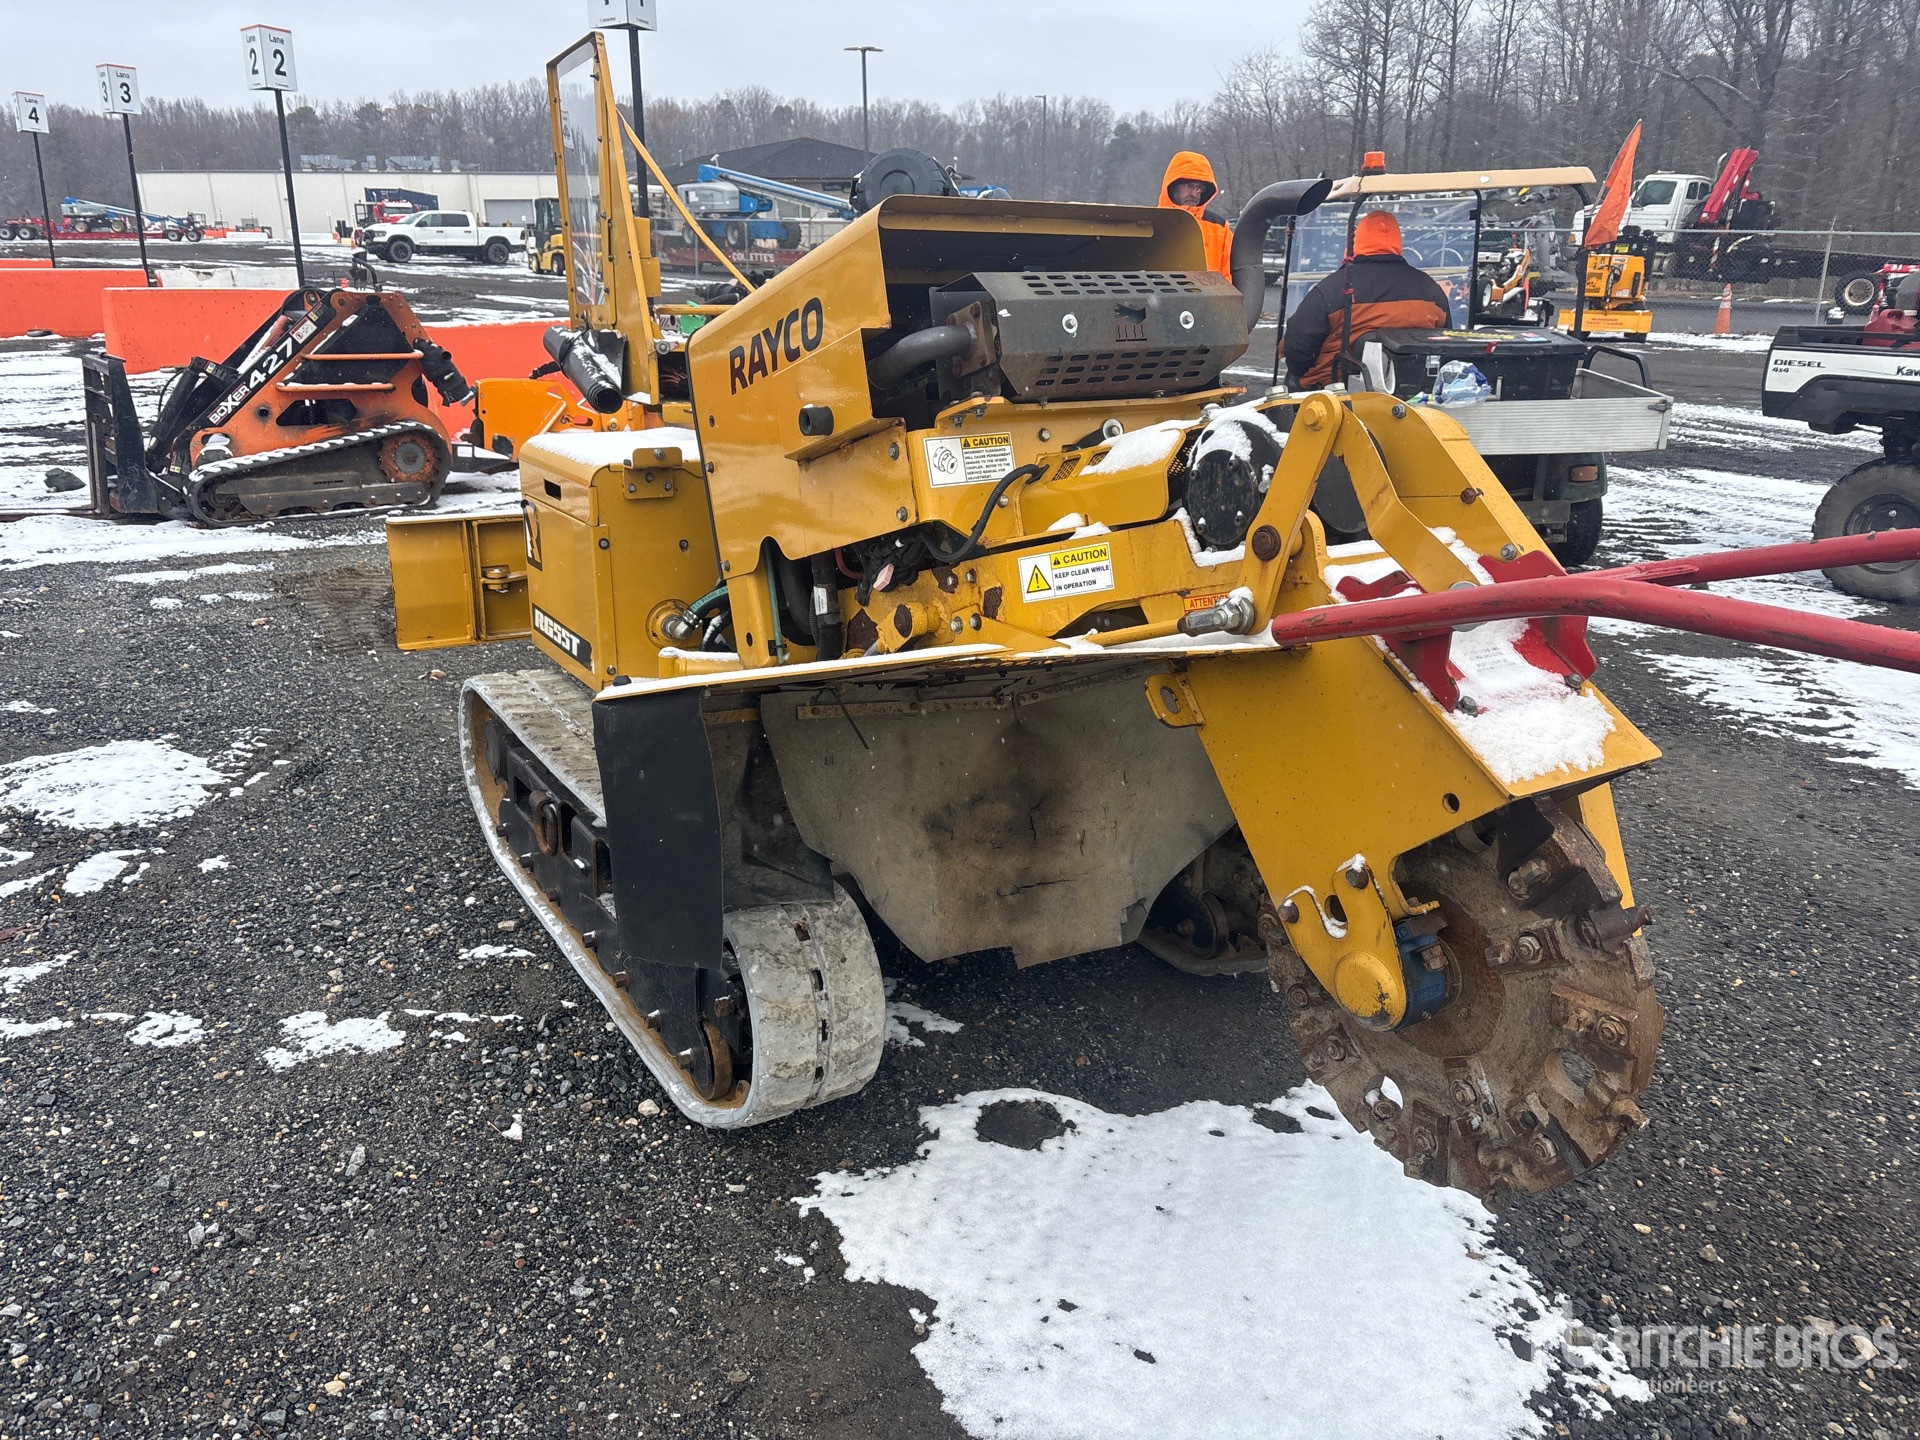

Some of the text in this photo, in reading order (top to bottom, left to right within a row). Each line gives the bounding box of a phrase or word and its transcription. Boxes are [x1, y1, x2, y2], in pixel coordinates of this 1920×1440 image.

[268, 33, 285, 44] Lane
[249, 48, 259, 76] 2
[272, 48, 287, 77] 2
[102, 80, 108, 102] 3
[120, 82, 132, 104] 3
[28, 106, 40, 124] 4
[729, 297, 824, 396] RAYCO
[1773, 359, 1826, 368] DIESEL
[208, 384, 250, 425] BOXER
[249, 337, 292, 389] 427
[972, 436, 1009, 447] CAUTION
[1063, 548, 1107, 564] CAUTION
[1054, 565, 1109, 579] KEEP CLEAR WHILE
[1064, 579, 1097, 590] OPERATION
[1190, 594, 1229, 608] ATTENT
[534, 608, 580, 657] RG55T
